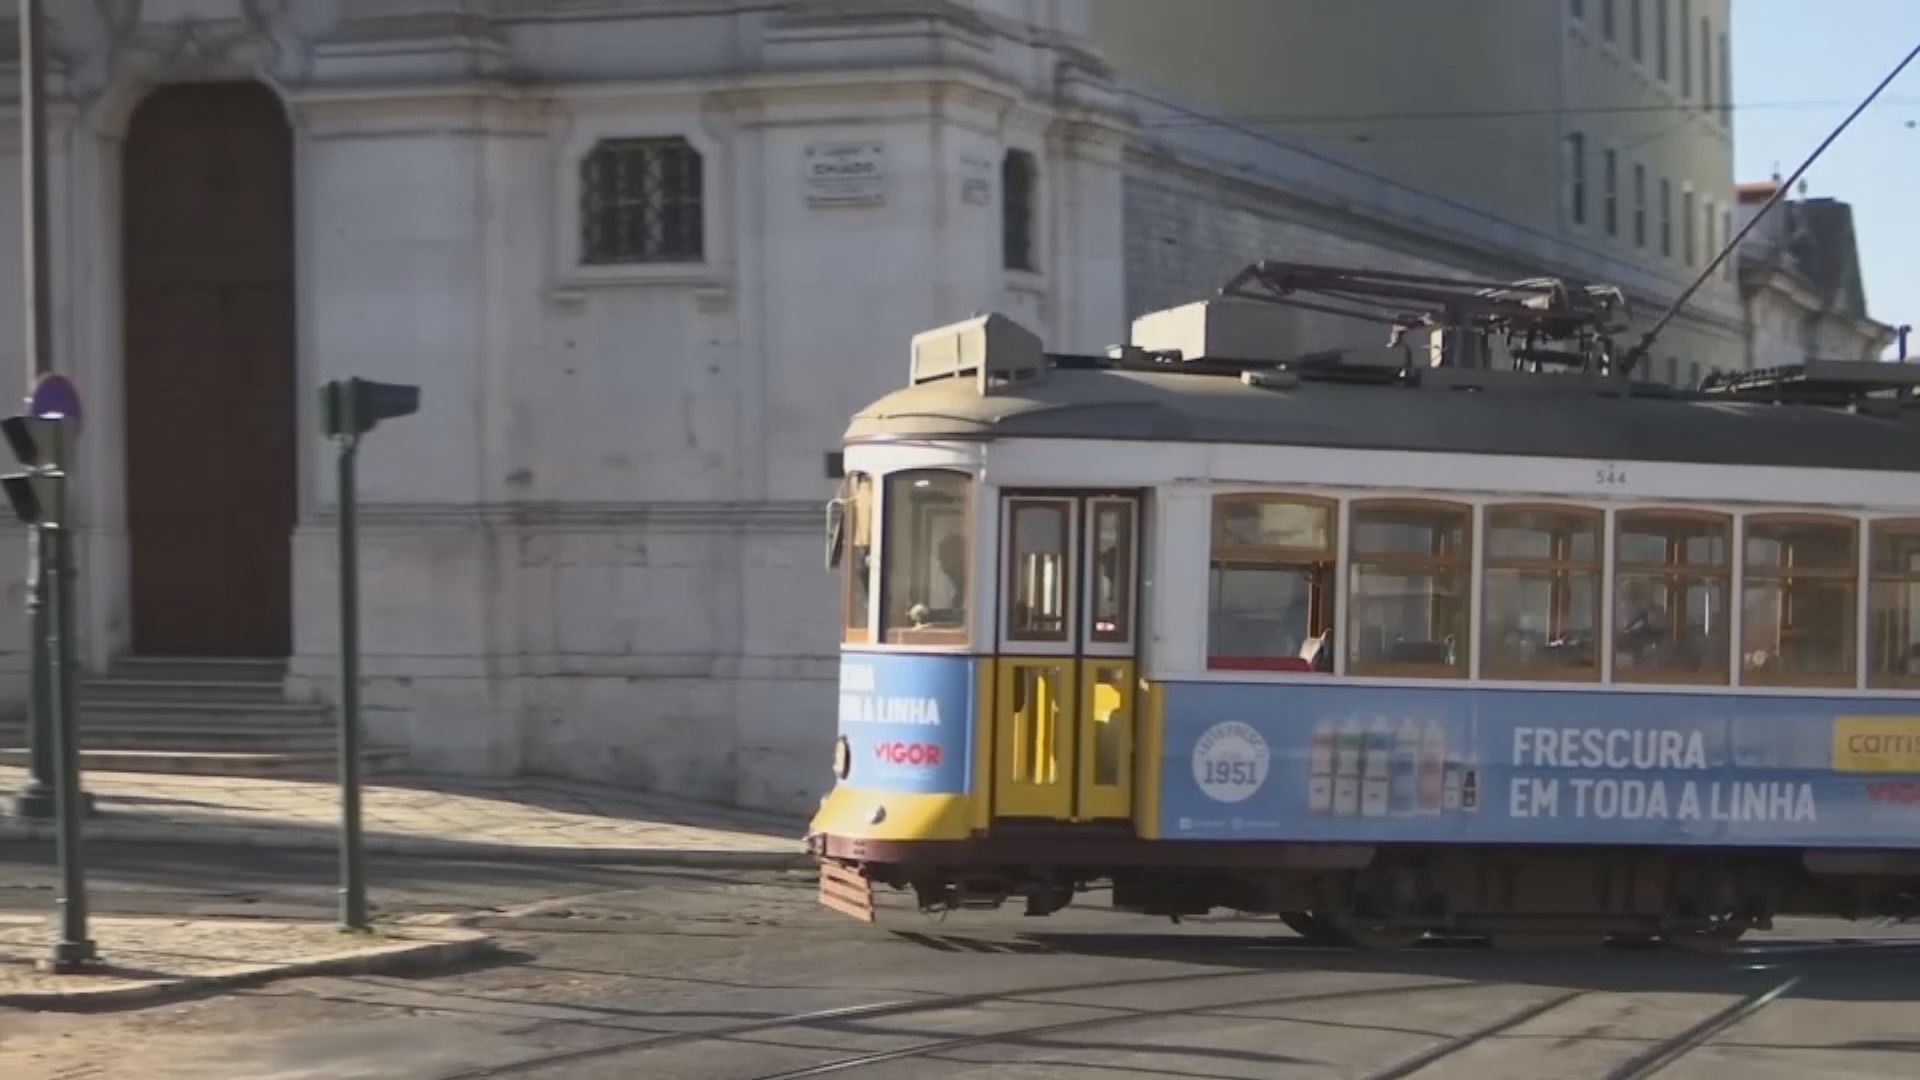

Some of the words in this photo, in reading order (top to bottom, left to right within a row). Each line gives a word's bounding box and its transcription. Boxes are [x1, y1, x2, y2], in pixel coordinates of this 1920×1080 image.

[1595, 469, 1626, 485] 544
[878, 697, 941, 725] LINHA
[874, 742, 944, 766] VIGOR
[1512, 726, 1707, 769] FRESCURA
[1203, 760, 1257, 785] 1951
[1509, 778, 1558, 818] EM
[1569, 779, 1668, 818] TODA
[1676, 780, 1701, 819] A
[1710, 782, 1816, 822] LINHA
